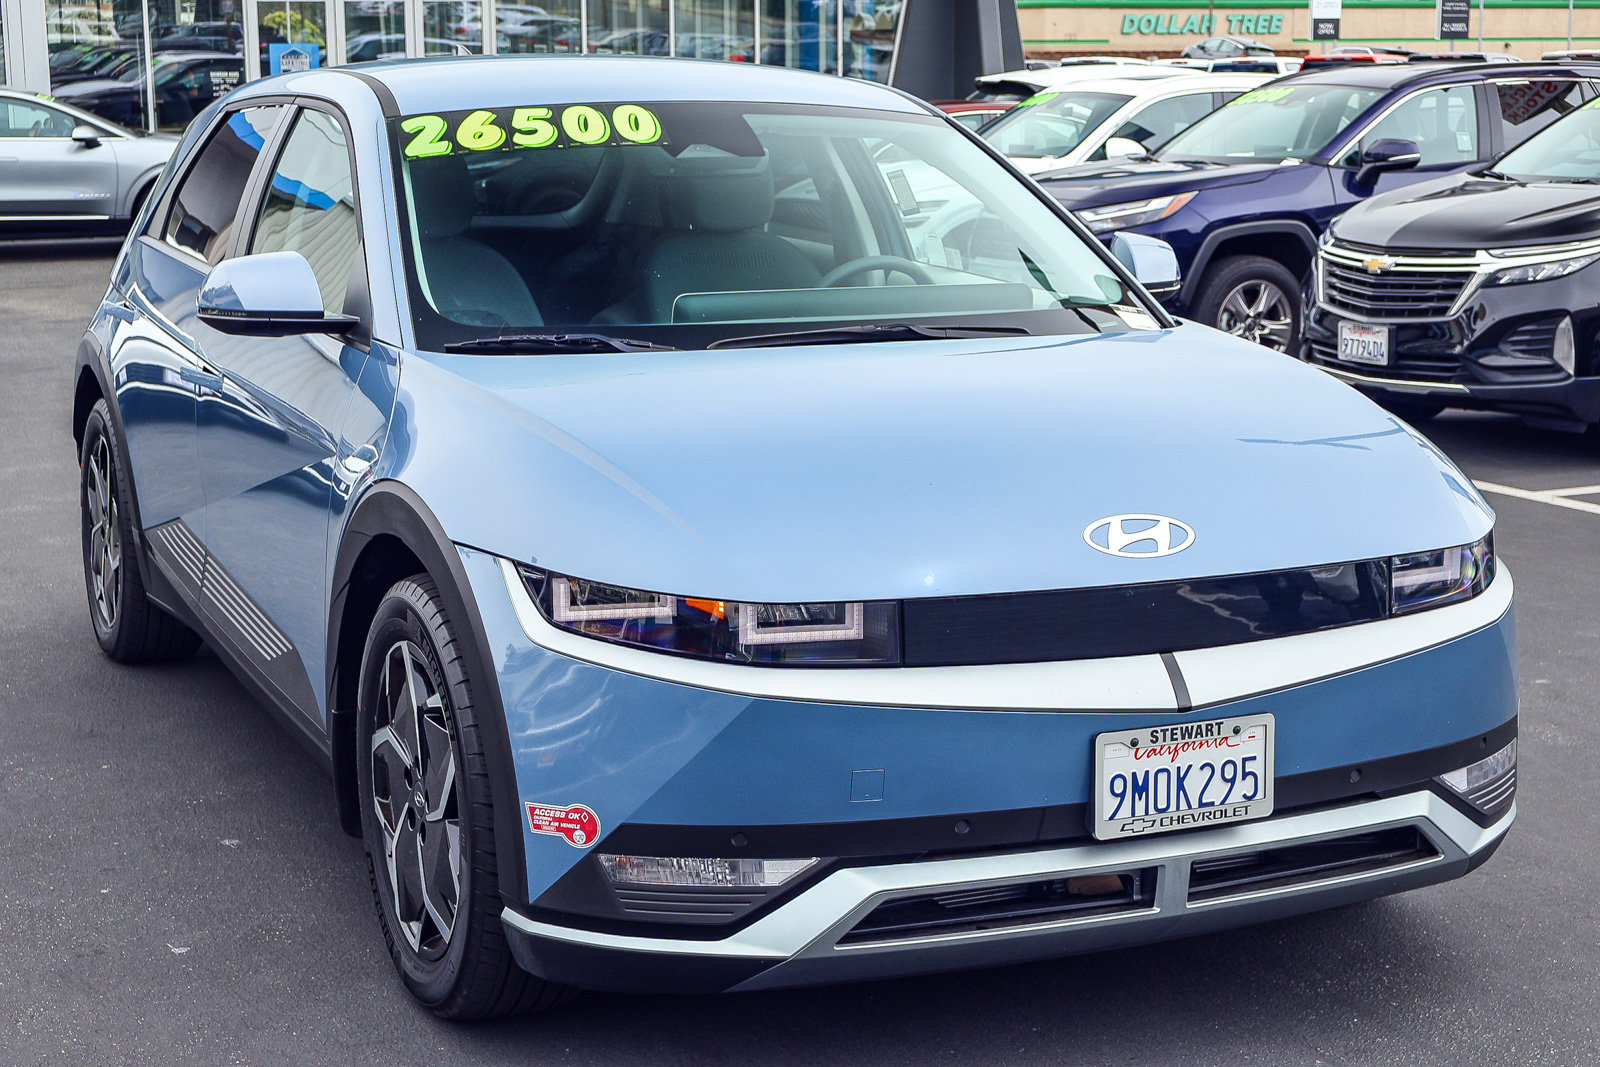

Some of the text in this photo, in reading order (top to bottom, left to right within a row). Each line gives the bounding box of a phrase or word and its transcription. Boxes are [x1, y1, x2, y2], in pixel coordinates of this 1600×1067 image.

[1121, 14, 1285, 35] DOLLAR TREE
[400, 103, 662, 158] 26500
[1150, 721, 1224, 744] STEWART
[1134, 736, 1241, 763] California
[1109, 755, 1259, 821] 9MOK295
[534, 808, 581, 820] ACCESS OK
[1159, 804, 1252, 828] CHEVROLET
